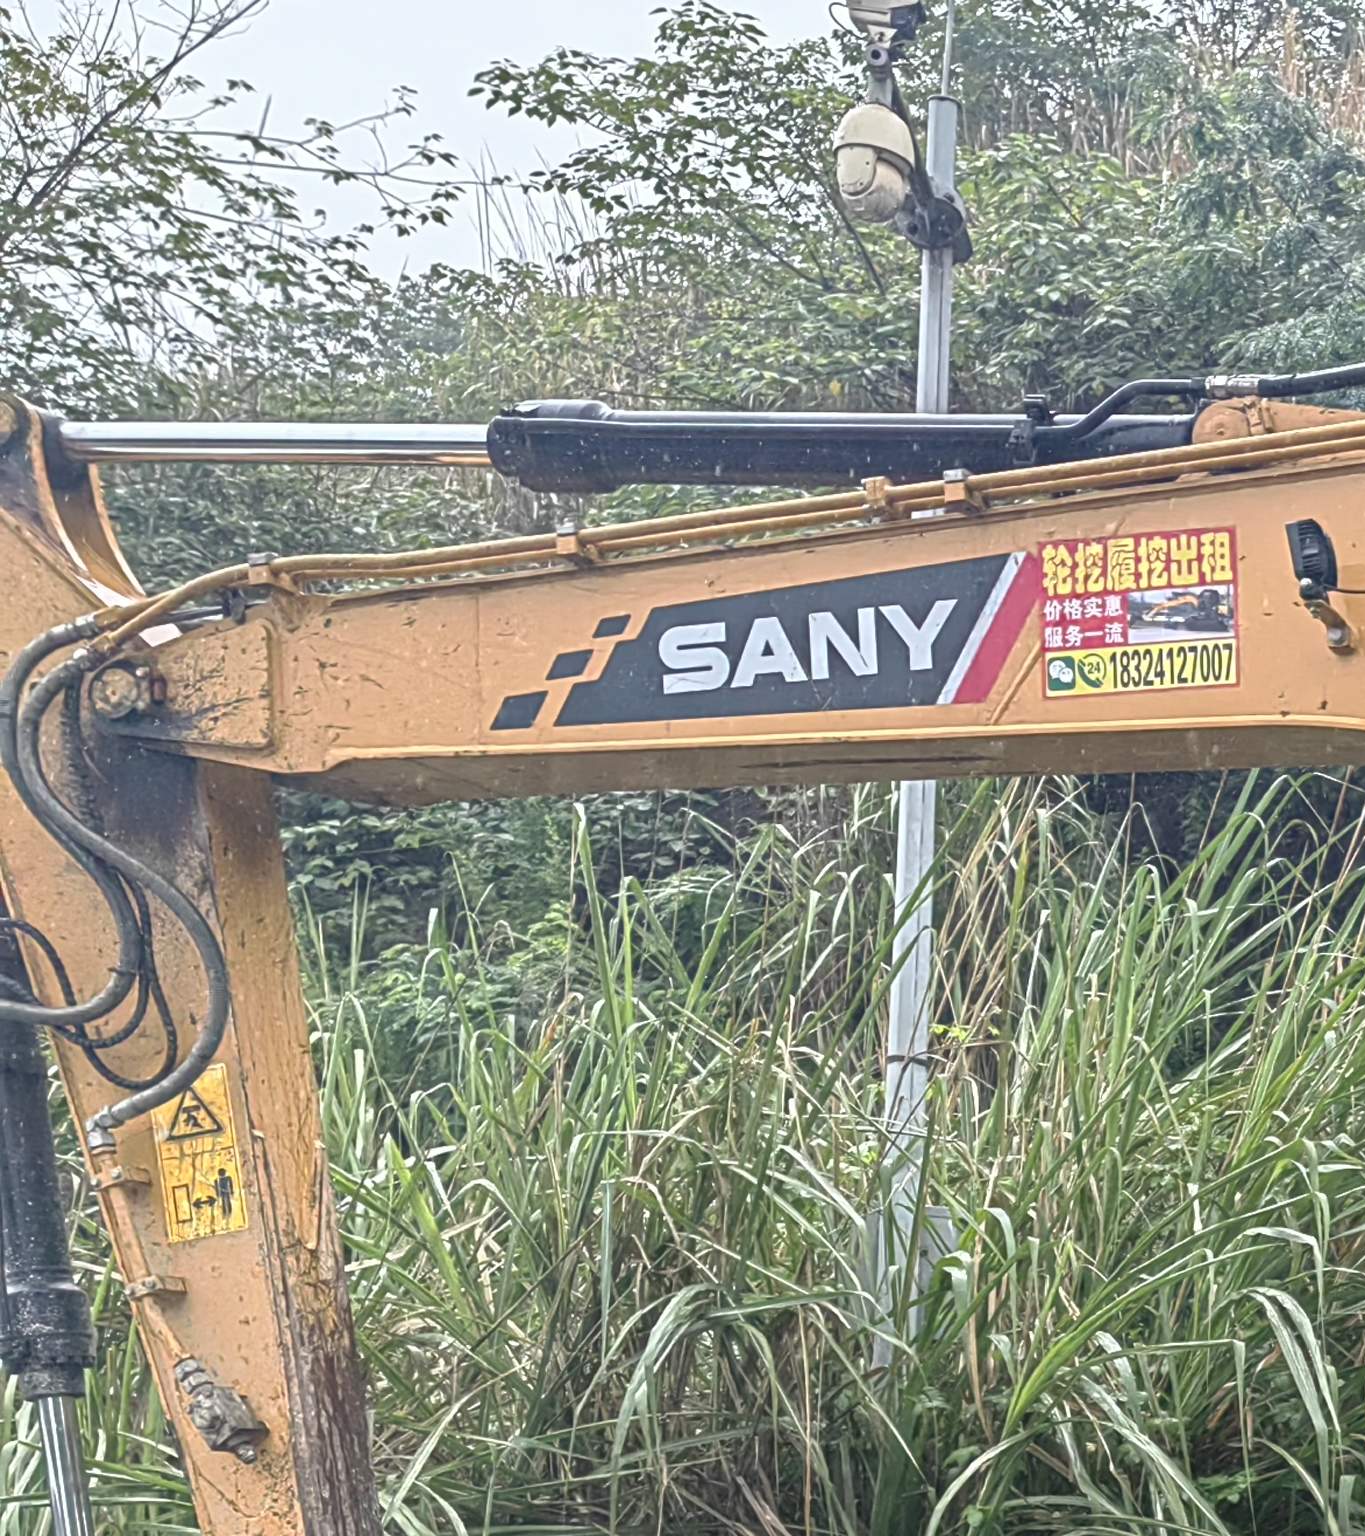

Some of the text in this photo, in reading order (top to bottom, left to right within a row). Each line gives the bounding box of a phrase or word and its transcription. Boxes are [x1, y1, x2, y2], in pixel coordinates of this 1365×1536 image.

[1041, 532, 1234, 596] 轮挖履挖出租
[1043, 595, 1124, 622] 价格实惠
[657, 598, 958, 696] SANY
[1043, 622, 1125, 648] 服务一流
[1109, 643, 1234, 690] 18324127007
